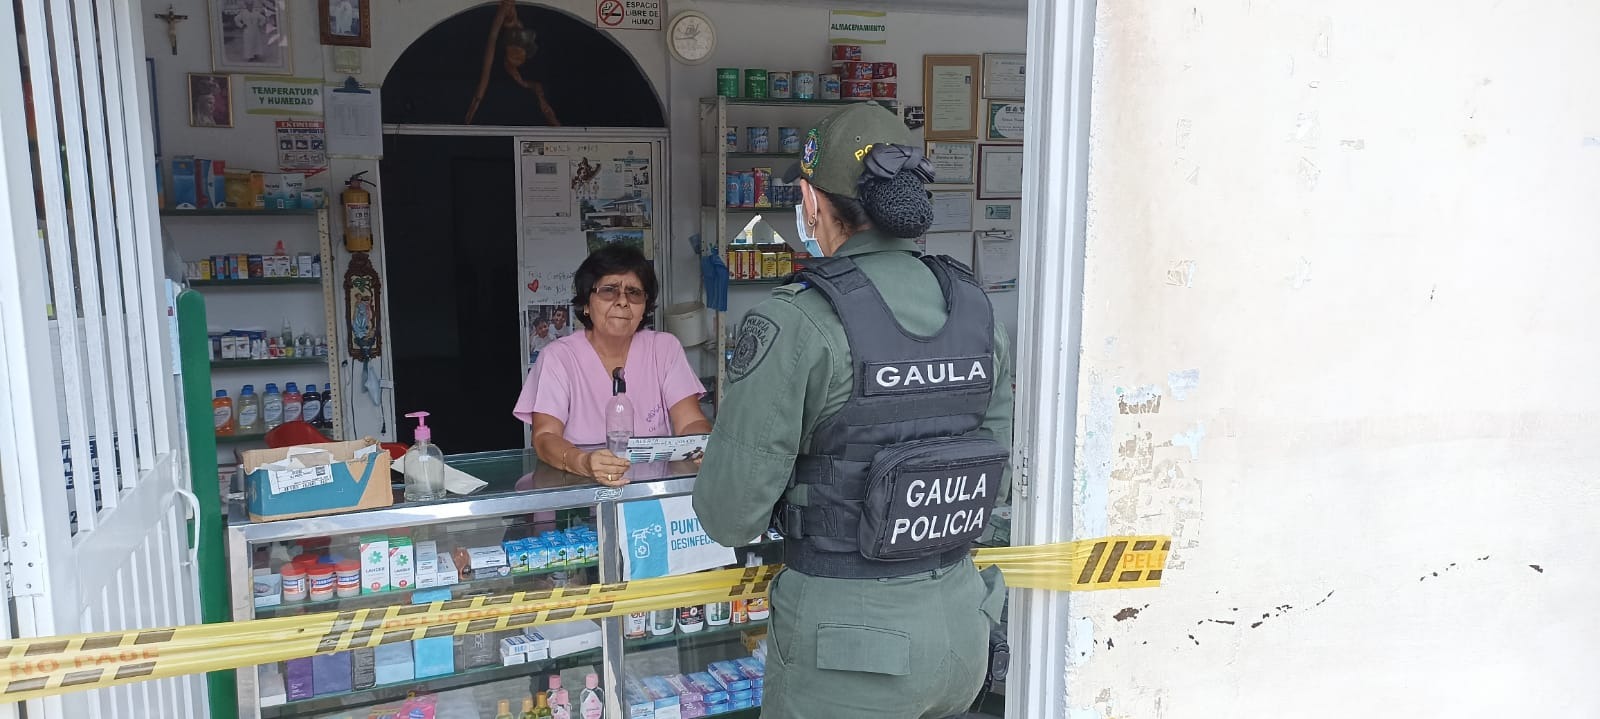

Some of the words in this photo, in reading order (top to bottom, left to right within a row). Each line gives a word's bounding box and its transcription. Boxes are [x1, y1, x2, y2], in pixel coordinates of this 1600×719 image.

[831, 23, 886, 32] ALMACENAMIENTO
[251, 86, 319, 96] TEMPERATURA
[258, 97, 264, 105] Y
[268, 97, 314, 105] HUMEDAD
[876, 361, 987, 387] GAULA
[906, 473, 987, 508] GAULA
[890, 507, 985, 545] POLICIA
[9, 659, 60, 679] NO
